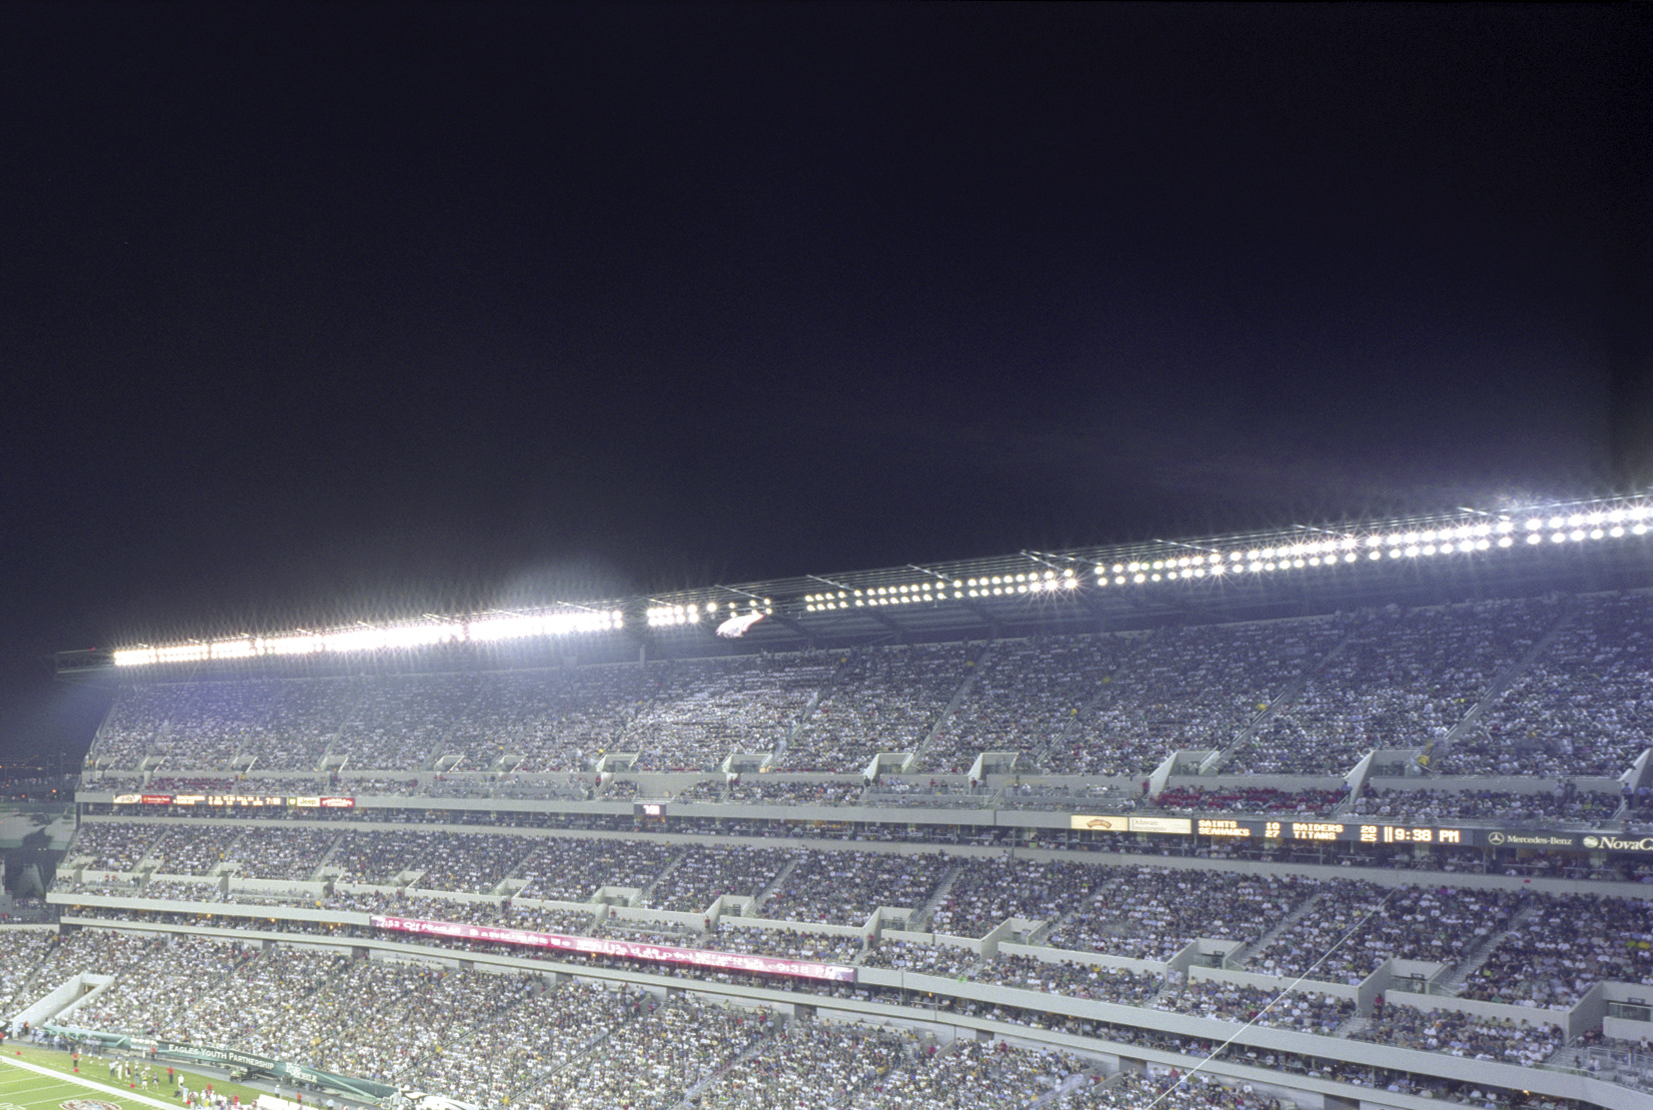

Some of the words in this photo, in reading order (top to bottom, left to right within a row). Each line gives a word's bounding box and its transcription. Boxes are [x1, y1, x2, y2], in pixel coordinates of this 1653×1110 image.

[300, 798, 317, 806] Jeep
[1198, 820, 1237, 828] SAINTS
[1266, 822, 1281, 830] 10
[1292, 822, 1344, 832] RAIDERS
[1198, 827, 1250, 837] SEAHAWKS
[1265, 830, 1281, 838] 27
[1293, 831, 1337, 840] TITANS
[1394, 828, 1432, 841] 9:38
[1439, 830, 1460, 843] PM
[1507, 835, 1573, 846] Mercedes-Benz
[1598, 836, 1653, 850] NovaC
[168, 1044, 199, 1055] EAGLES
[200, 1048, 227, 1060] YOUTH
[229, 1053, 275, 1070] PARTNERSHIP
